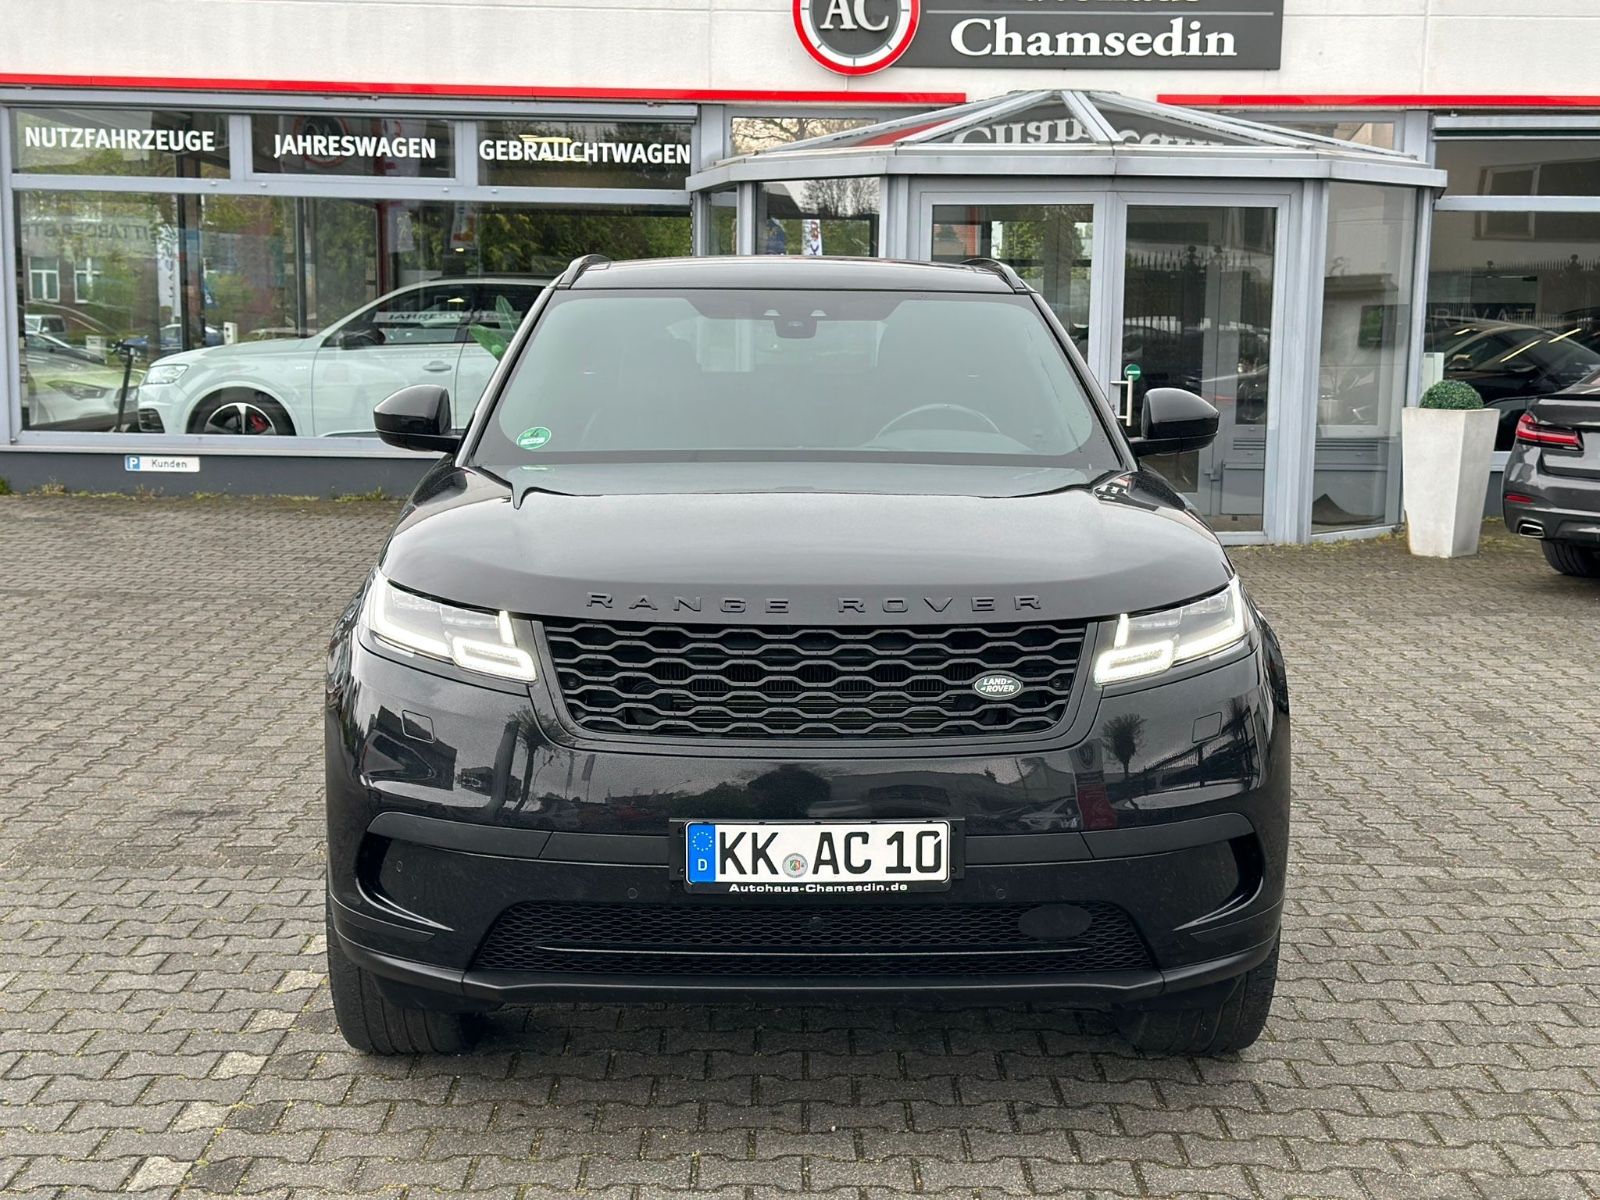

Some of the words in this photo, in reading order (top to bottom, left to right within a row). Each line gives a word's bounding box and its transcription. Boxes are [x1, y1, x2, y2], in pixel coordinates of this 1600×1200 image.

[820, 0, 891, 31] AC
[950, 17, 1237, 57] Chamsedin
[25, 126, 216, 152] NUTZFAHRZEUGE
[273, 133, 437, 160] JAHRESWAGEN
[478, 138, 691, 165] GEBRAUCHTWAGEN
[128, 457, 138, 469] P
[151, 459, 187, 469] Kunden
[586, 591, 790, 614] RANGE
[837, 594, 1042, 614] ROVER
[983, 678, 1007, 686] LAND
[986, 684, 1015, 693] ROVER
[697, 858, 708, 871] D
[719, 831, 779, 875] KK
[811, 831, 872, 875] AC
[885, 830, 942, 874] 10
[728, 883, 908, 894] Autohaus-Chamsedin.de
